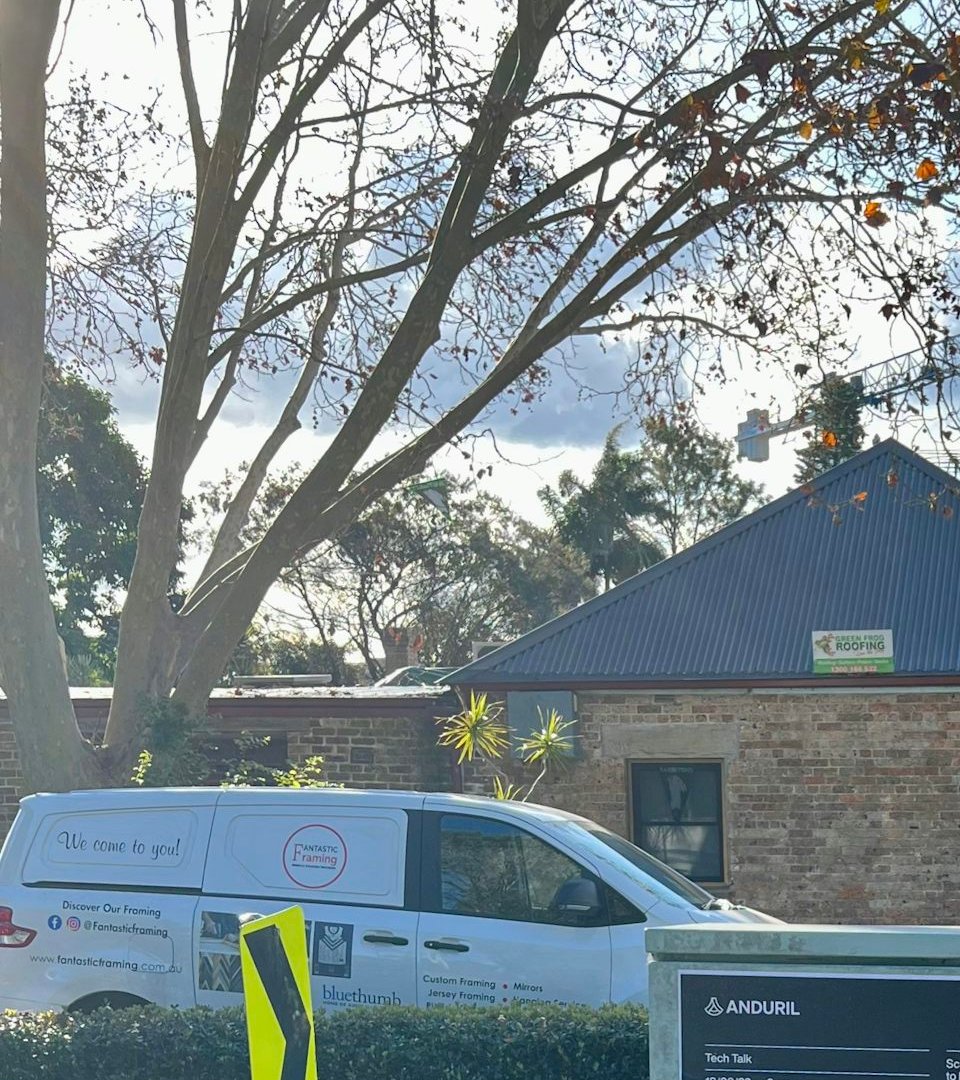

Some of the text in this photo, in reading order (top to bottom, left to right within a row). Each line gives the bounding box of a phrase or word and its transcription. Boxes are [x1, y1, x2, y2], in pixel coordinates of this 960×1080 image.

[835, 641, 885, 651] ROOFING
[57, 831, 181, 860] We come to you!
[62, 901, 161, 919] Discover Our Framing
[422, 974, 543, 992] Custom Framing Mirrors
[323, 984, 401, 1006] bluethumb
[427, 989, 457, 1000] Jersey
[459, 991, 496, 1003] Framing
[726, 1000, 800, 1015] ANDURIL
[704, 1052, 752, 1064] Tech Talk
[945, 1072, 957, 1080] to
